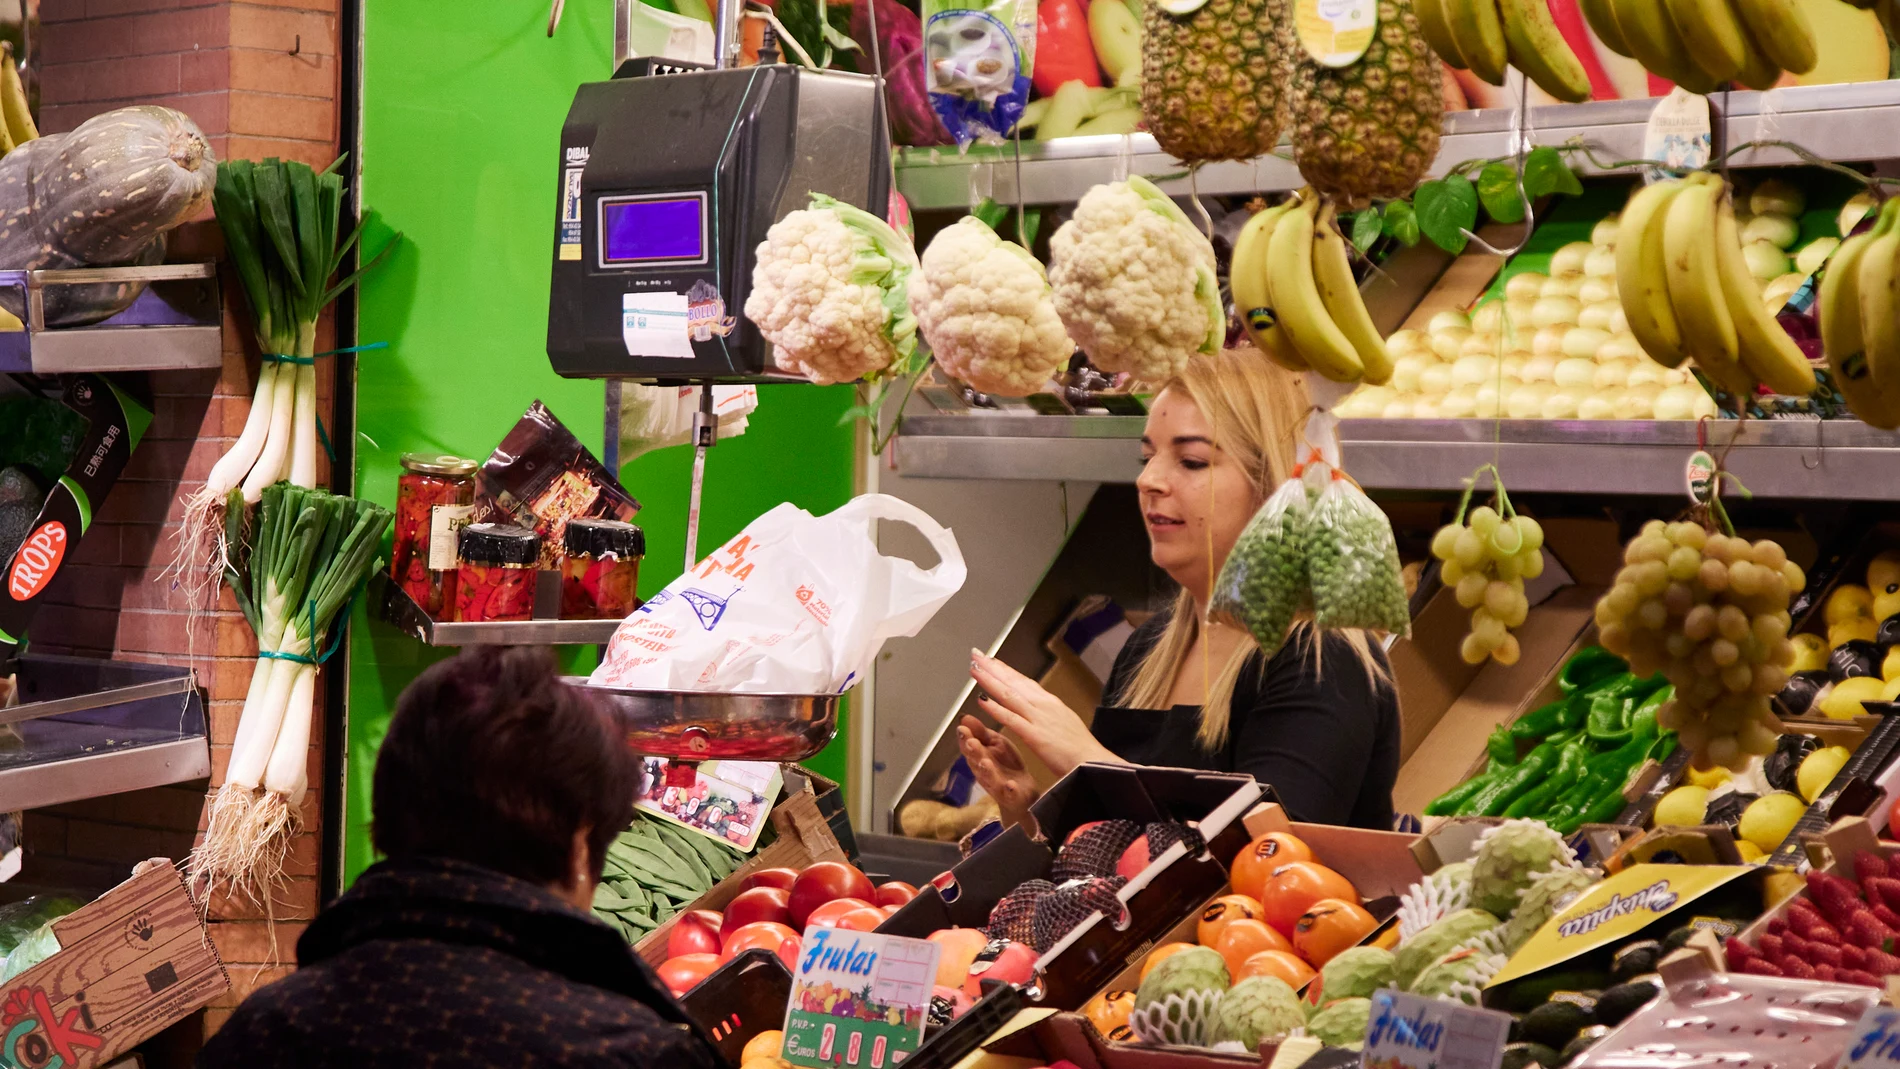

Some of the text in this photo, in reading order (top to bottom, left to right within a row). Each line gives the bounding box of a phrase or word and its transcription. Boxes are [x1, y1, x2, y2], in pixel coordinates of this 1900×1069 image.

[567, 147, 590, 160] DIBAL
[688, 303, 718, 321] BOLLO
[11, 523, 67, 598] TROPS
[801, 930, 879, 976] Frutas
[1125, 938, 1154, 966] PREMIUM
[1369, 993, 1445, 1053] Frutas
